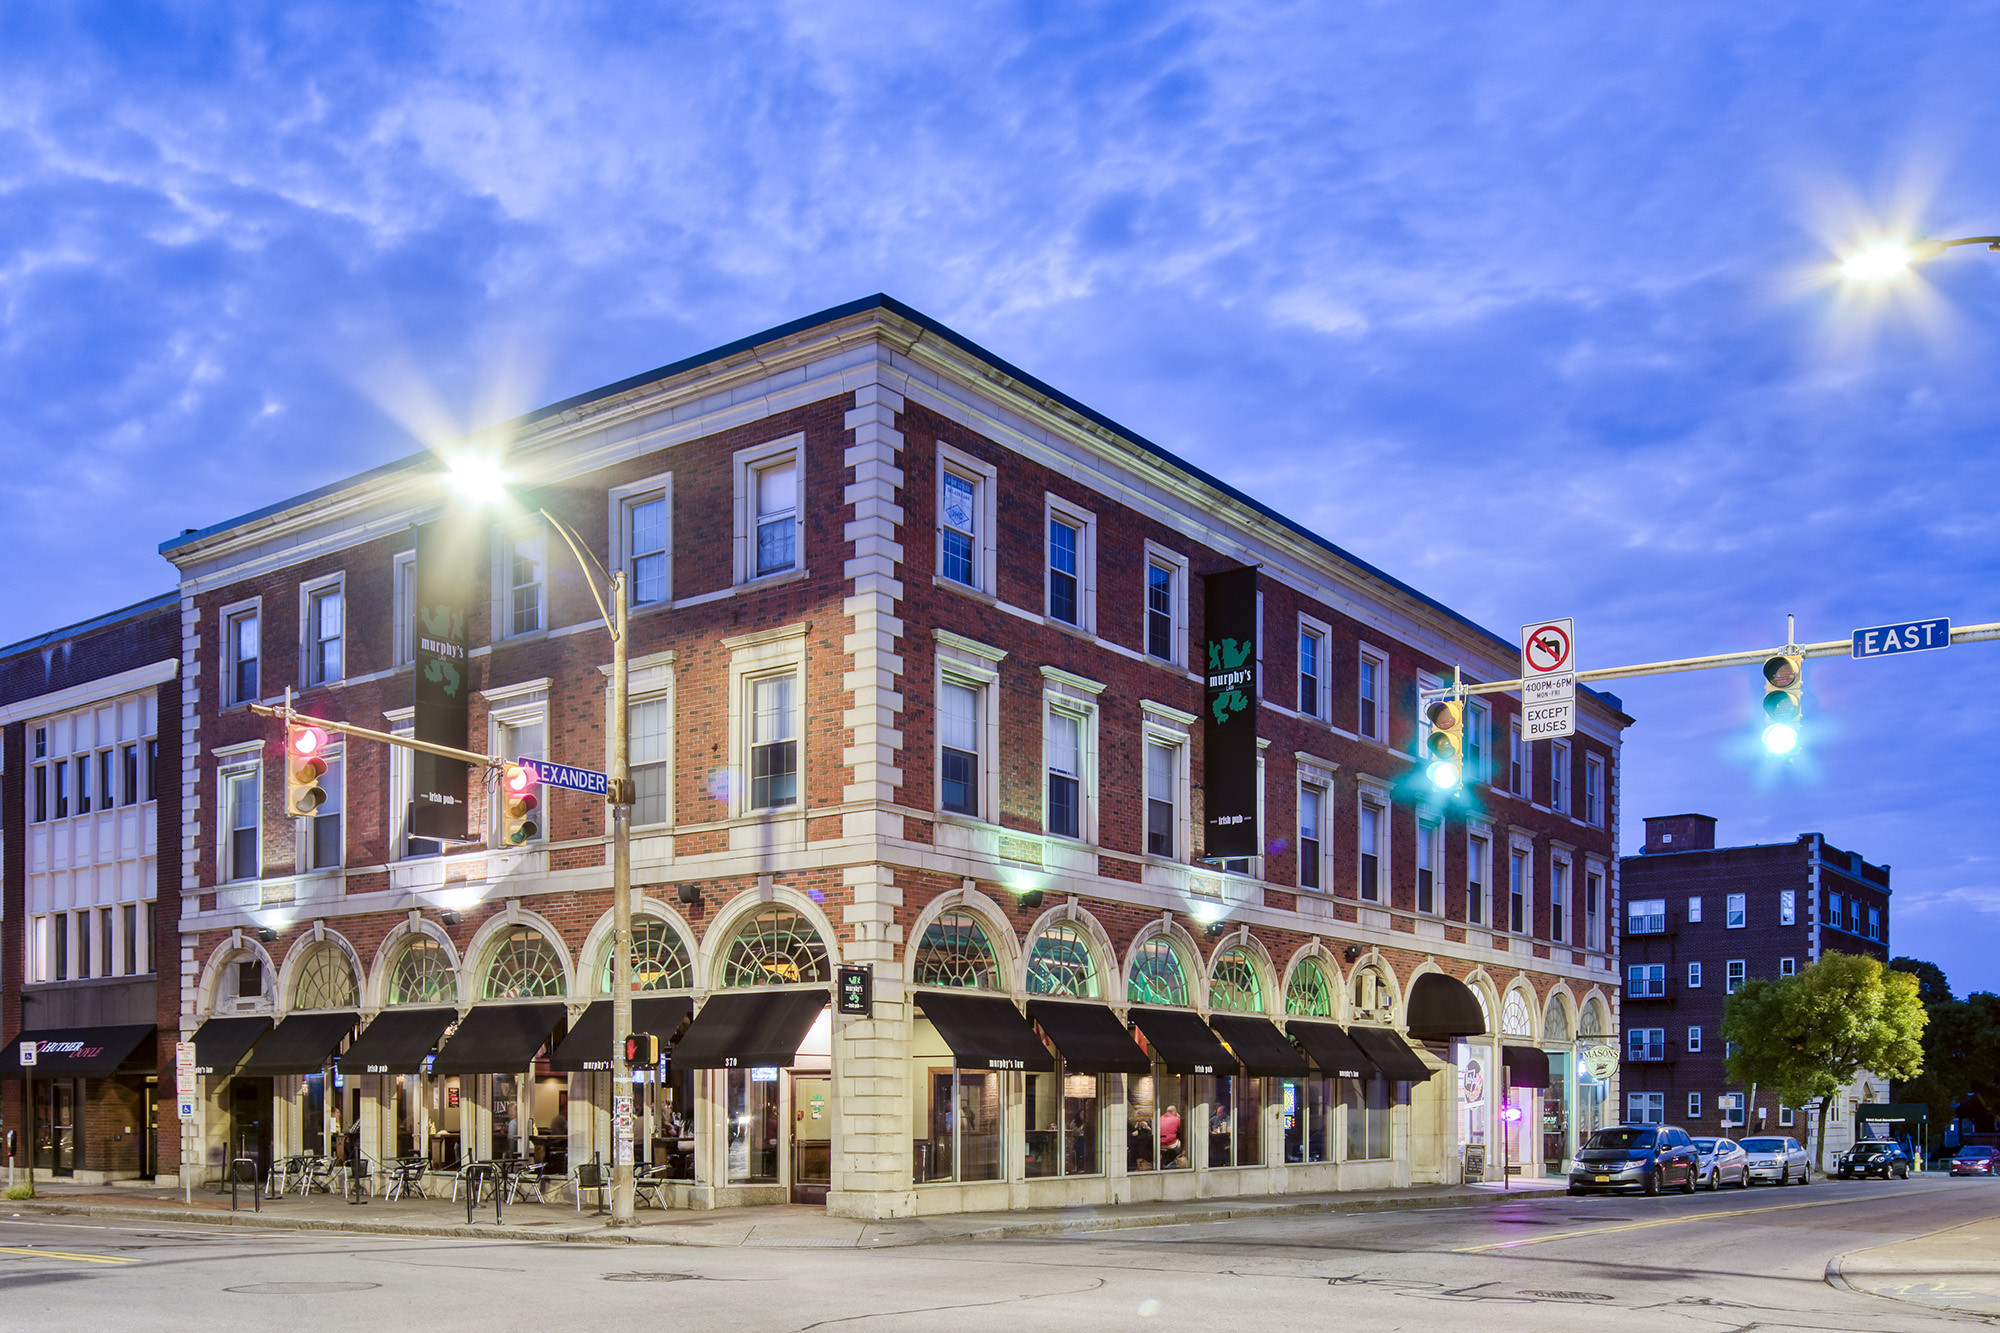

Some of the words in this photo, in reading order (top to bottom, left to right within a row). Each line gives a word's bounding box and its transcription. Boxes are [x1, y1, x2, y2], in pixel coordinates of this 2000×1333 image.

[1865, 623, 1936, 654] EAST
[421, 637, 464, 659] murphy's
[1209, 669, 1251, 688] murphy's
[1536, 690, 1561, 699] MON-FRI
[1527, 706, 1569, 721] EXCEPT
[1531, 720, 1567, 734] BUSES
[443, 795, 455, 805] pub
[1232, 814, 1243, 826] pub
[1583, 1049, 1619, 1058] MASONS
[583, 1060, 609, 1071] murphy's
[725, 1057, 738, 1067] 370
[989, 1059, 1013, 1070] murphy's
[1014, 1060, 1024, 1069] law
[378, 1064, 388, 1074] pub
[1205, 1065, 1213, 1074] pub
